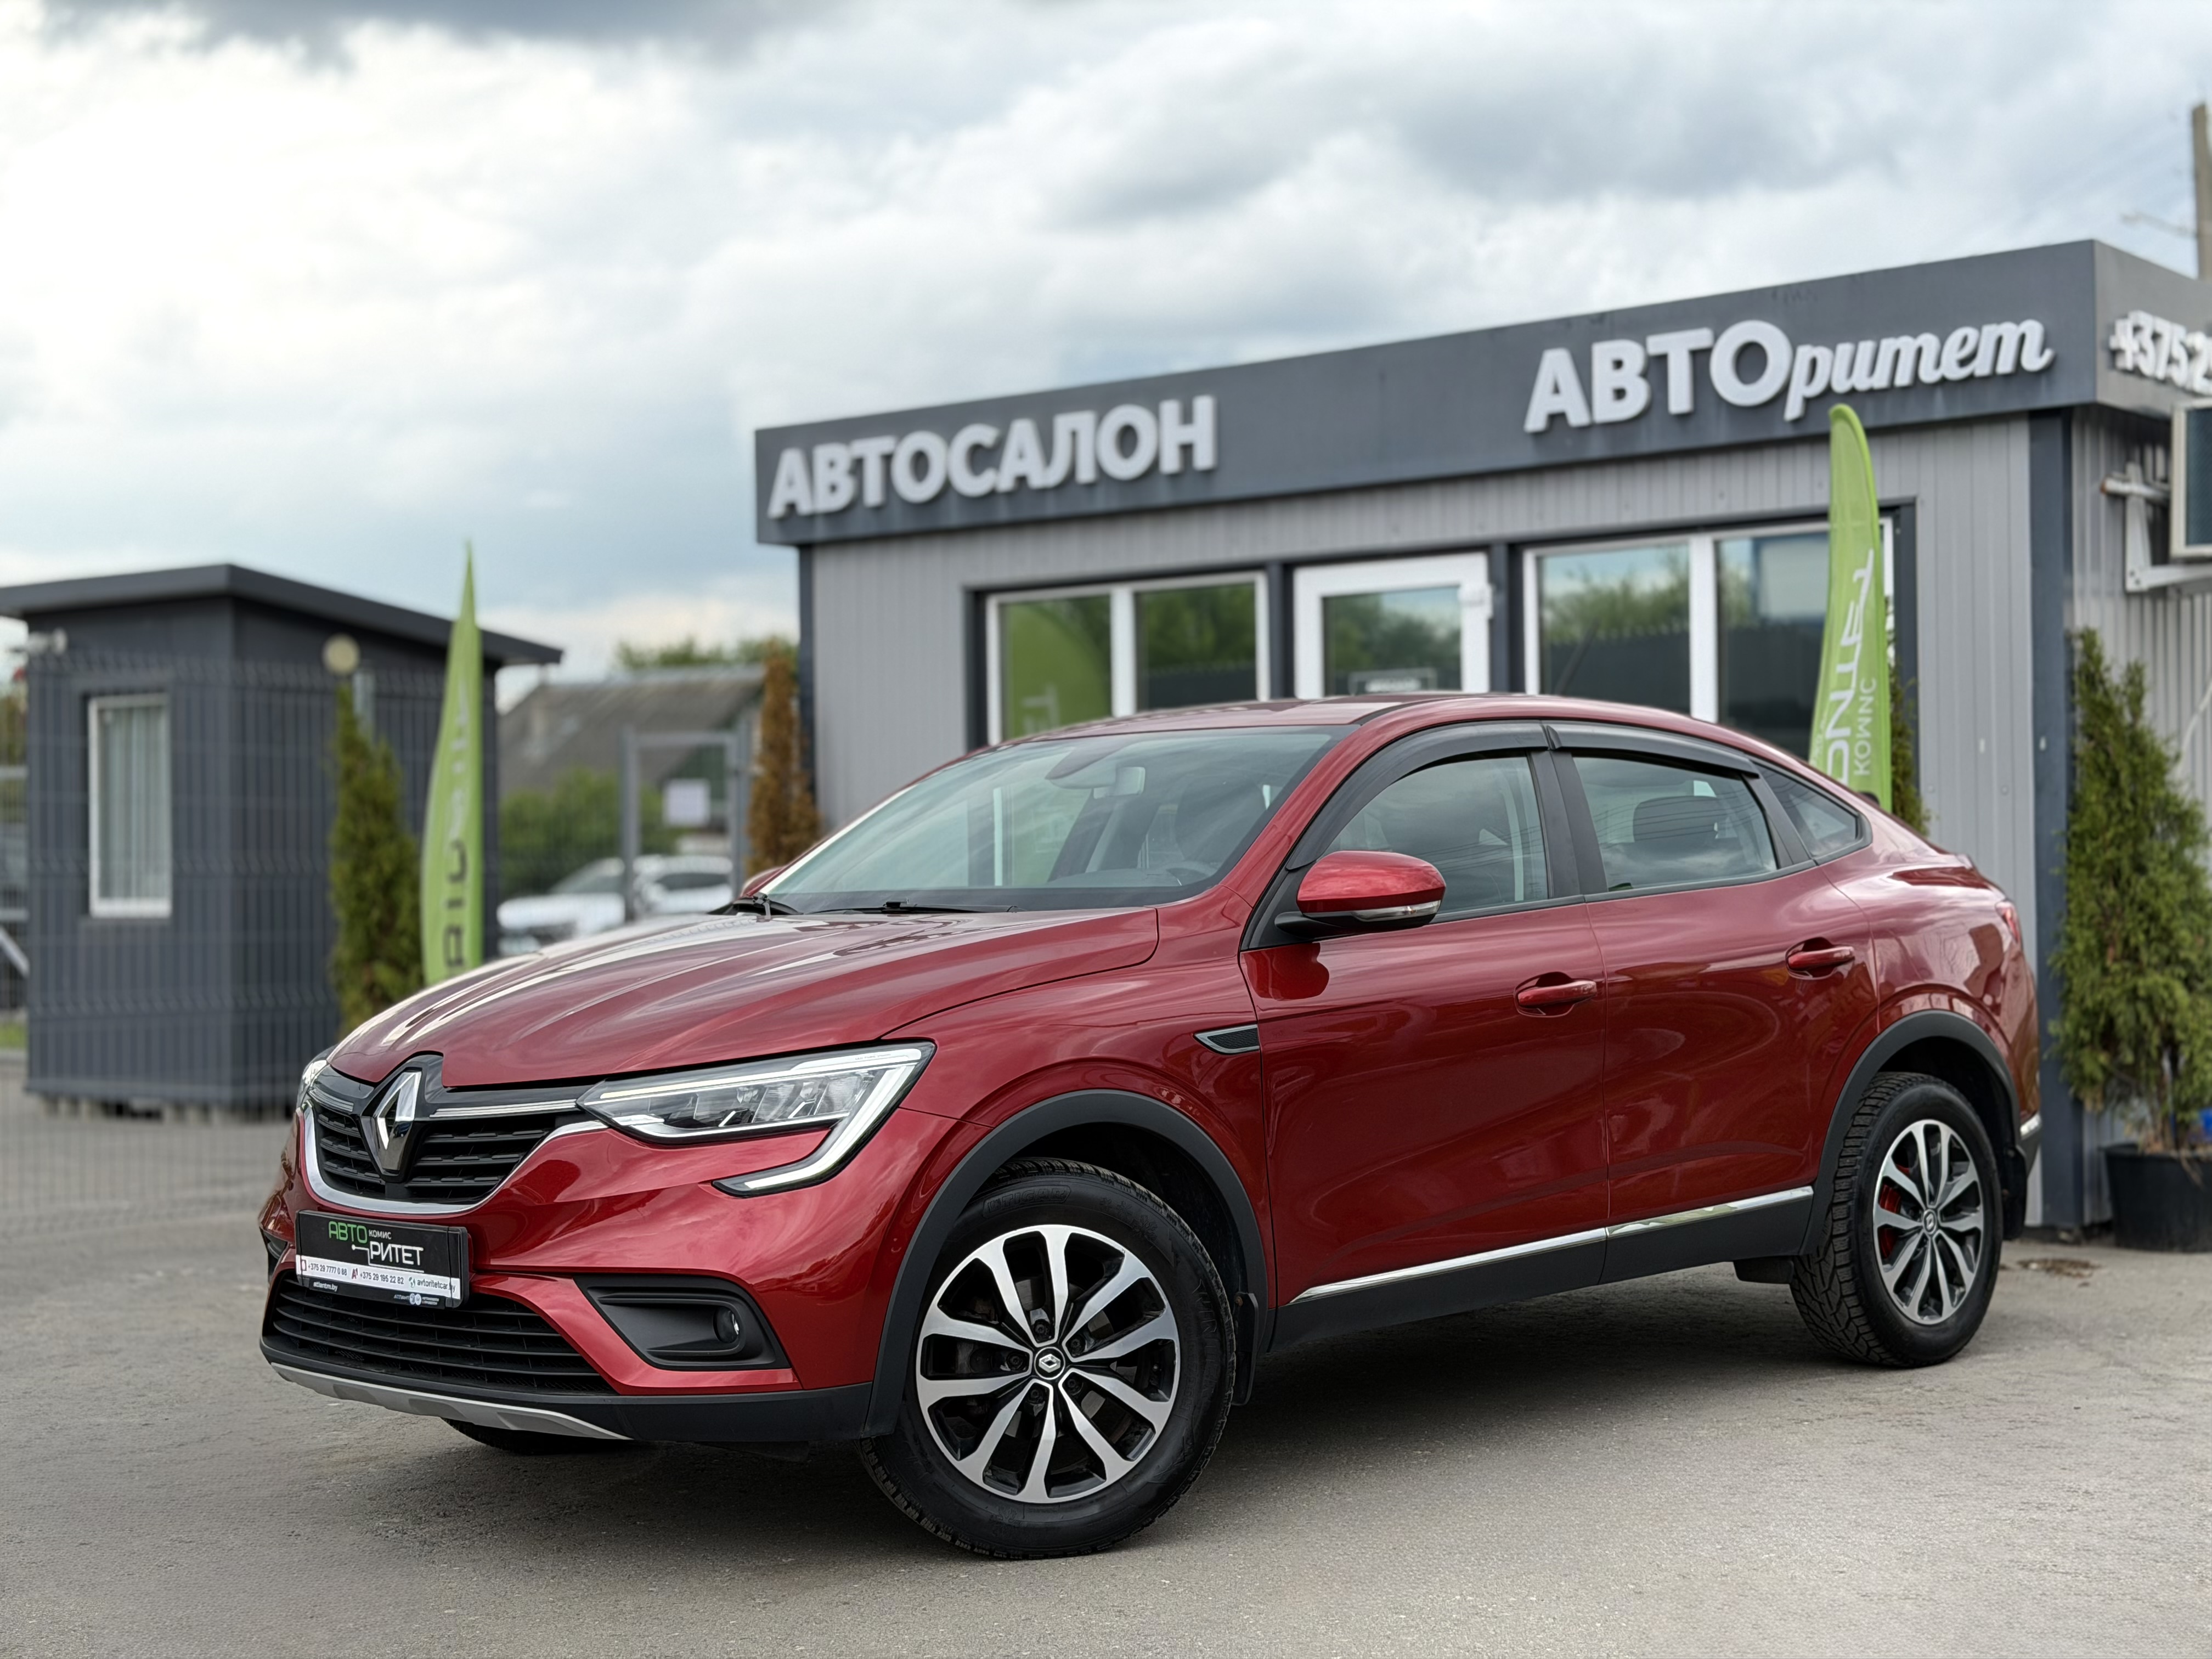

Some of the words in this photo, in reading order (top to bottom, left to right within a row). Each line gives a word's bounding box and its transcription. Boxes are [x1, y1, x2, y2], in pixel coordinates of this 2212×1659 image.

[2109, 310, 2212, 396] +3752
[1523, 319, 2056, 432] АВТОритет
[768, 395, 1217, 519] АВТОСАЛОН
[329, 1221, 368, 1244] АВТО
[369, 1229, 392, 1240] КОМИС
[370, 1241, 424, 1266] РИТЕТ
[308, 1263, 319, 1271] +375
[326, 1266, 337, 1274] 7777
[360, 1272, 372, 1280] +375
[380, 1274, 389, 1283] 195
[390, 1276, 396, 1284] 22
[397, 1277, 404, 1285] 82
